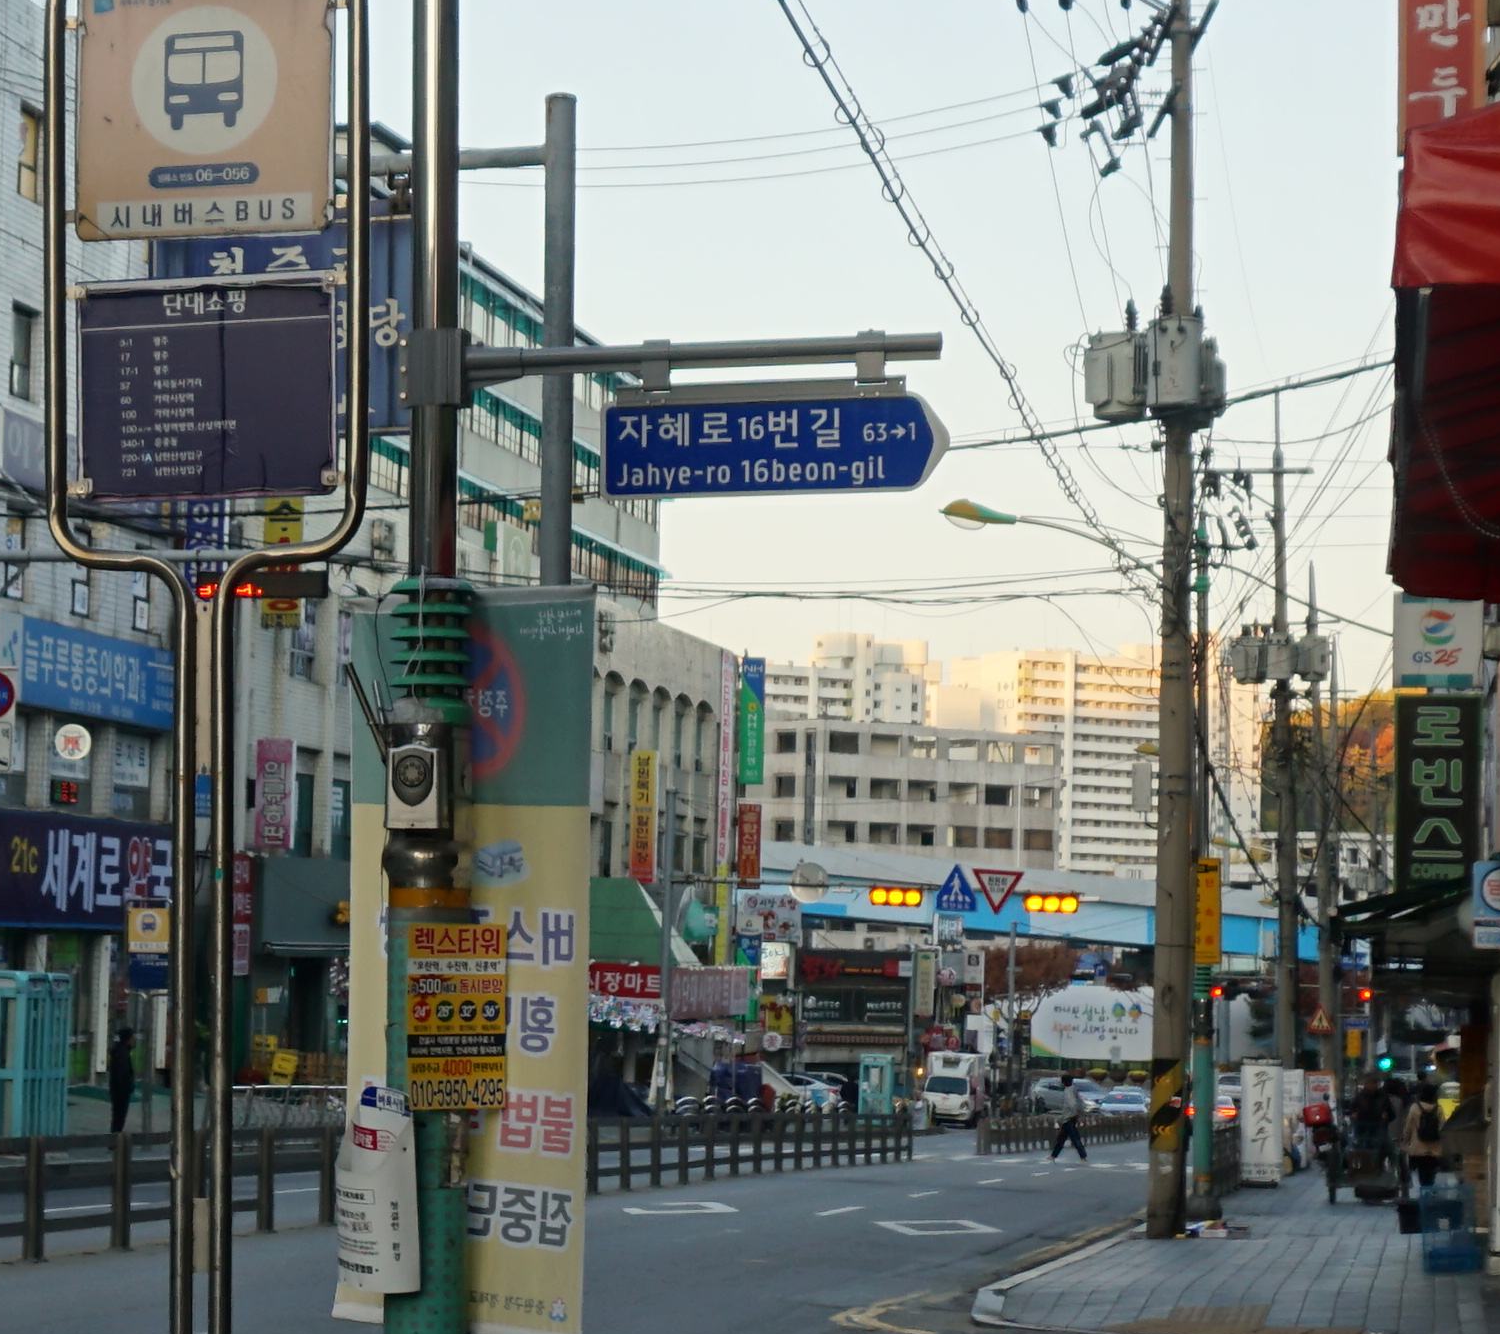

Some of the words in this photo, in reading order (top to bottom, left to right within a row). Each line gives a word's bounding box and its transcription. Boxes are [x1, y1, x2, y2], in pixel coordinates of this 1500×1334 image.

[163, 290, 246, 316] 단대쇼핑
[617, 463, 731, 489] Jahye-ro
[741, 456, 885, 484] 16beon-gil
[1412, 648, 1462, 666] GS25
[1412, 705, 1464, 858] 로빈스
[415, 928, 500, 954] 렉스타워
[460, 979, 502, 994] 동시분양
[442, 1060, 472, 1076] 4000
[411, 1079, 503, 1107] 010-5950-4295
[1250, 1069, 1274, 1154] 주짓수
